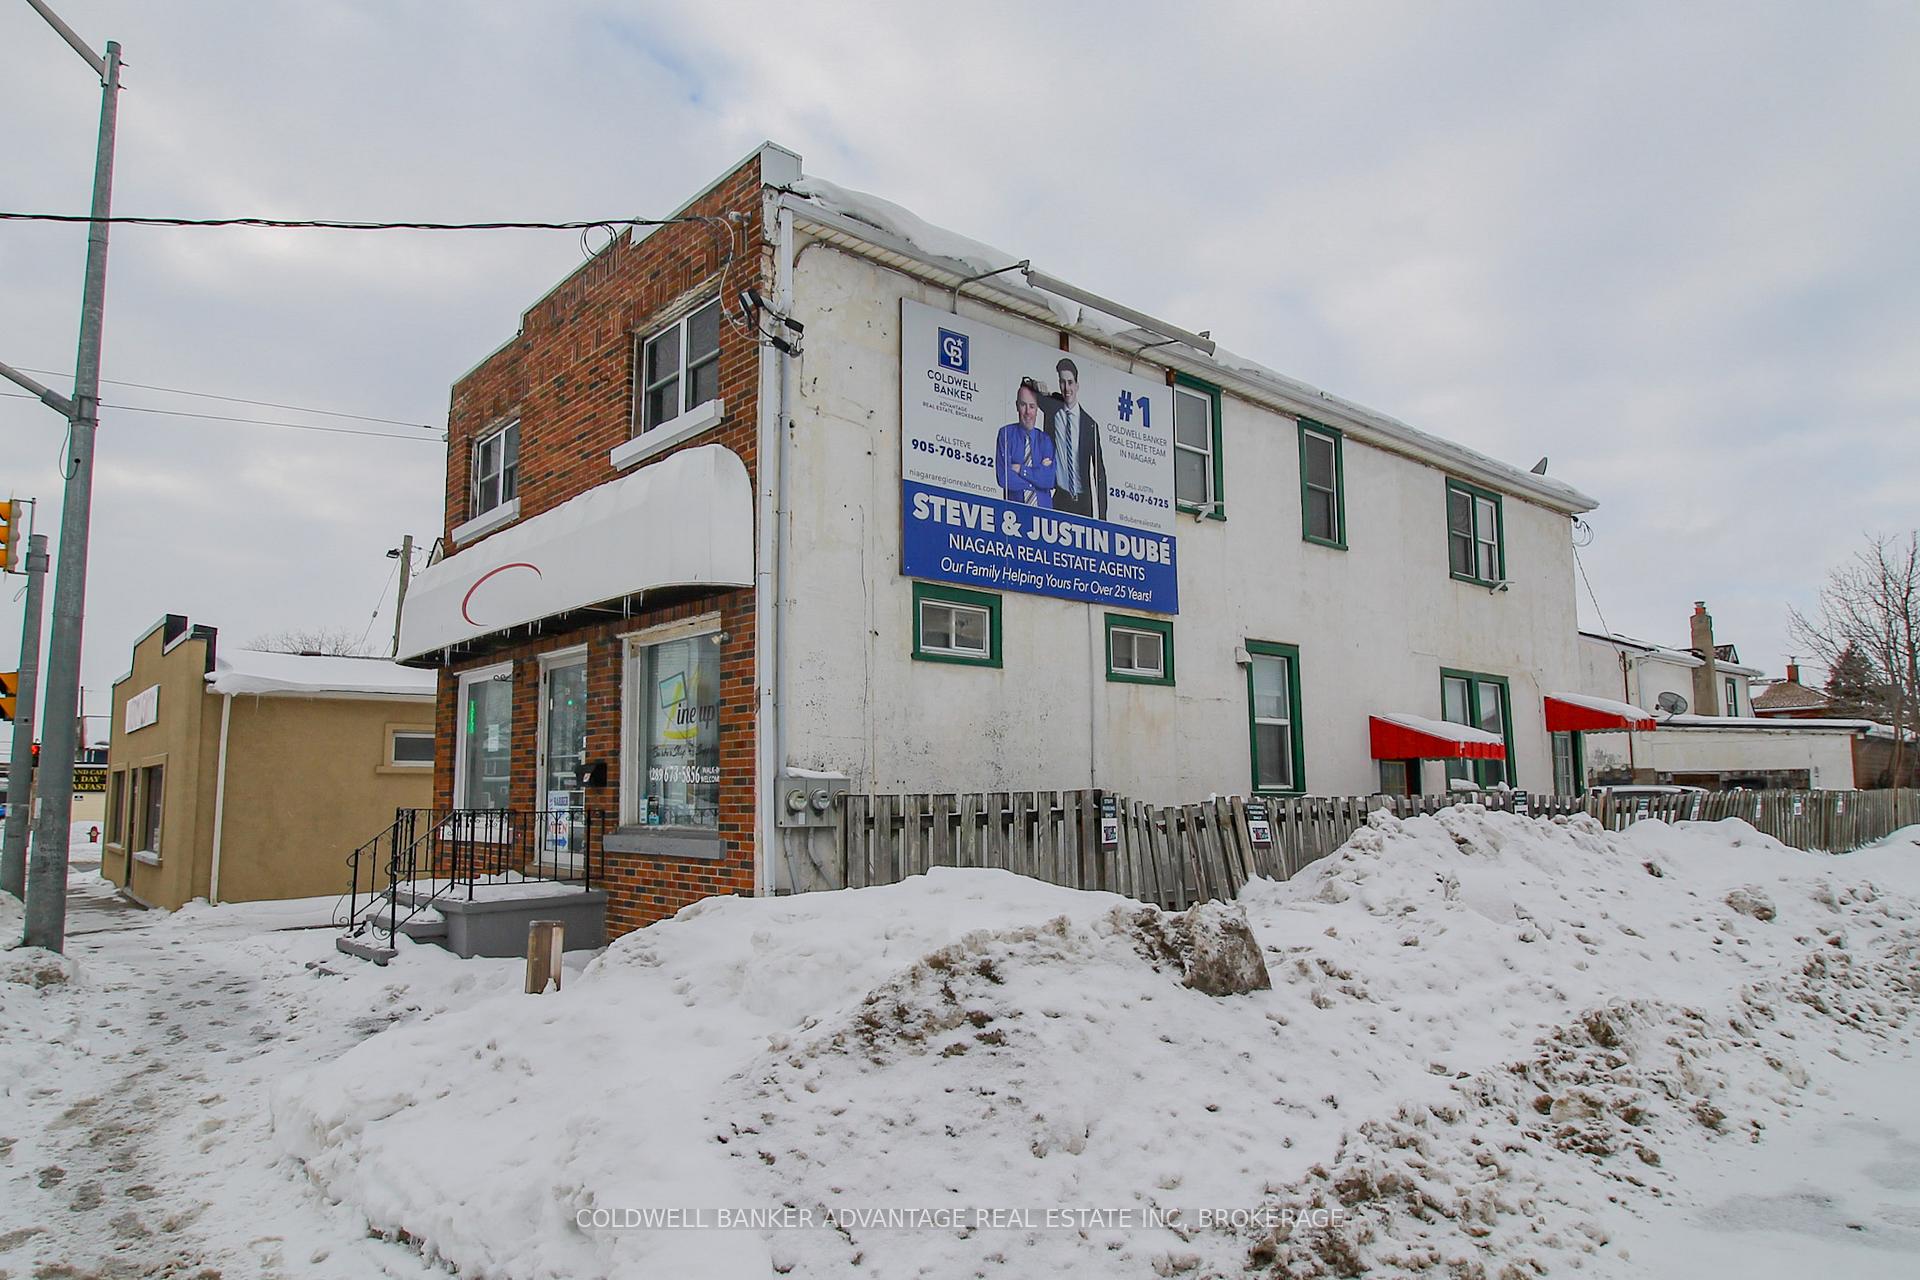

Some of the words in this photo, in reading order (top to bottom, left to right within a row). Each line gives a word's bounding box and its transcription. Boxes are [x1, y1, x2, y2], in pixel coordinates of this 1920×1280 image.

[927, 369, 979, 392] COLDWELL
[934, 383, 973, 402] BANKER
[922, 401, 936, 410] REAL
[955, 410, 984, 422] BROKERAGE
[940, 401, 967, 412] ADVANTAGE
[1118, 390, 1150, 428] #1
[936, 434, 951, 445] CALL
[953, 438, 972, 449] STEVE
[1107, 423, 1142, 439] COLDWELL
[1143, 433, 1167, 446] BANKER
[1109, 435, 1125, 447] REAL
[1126, 440, 1148, 453] ESTATE
[1149, 446, 1166, 457] TEAM
[912, 439, 994, 468] 905-708-5622
[1120, 449, 1127, 459] IN
[1128, 452, 1157, 466] NIAGARA
[909, 468, 997, 493] niagararegionrealtors.com
[1125, 481, 1136, 491] CALL
[1138, 485, 1154, 494] JUSTIN
[1109, 487, 1169, 509] 289-407-6725
[912, 492, 996, 533] STEVE
[1001, 510, 1022, 538] &
[1026, 515, 1109, 554] JUSTIN
[1115, 537, 1171, 565] DUBÉ
[949, 533, 1014, 559] NIAGARA
[1018, 545, 1050, 565] REAL
[1053, 551, 1097, 573] ESTATE
[1099, 560, 1146, 581] AGENTS
[941, 556, 965, 573] Our
[966, 560, 1001, 582] Family
[1002, 566, 1044, 589] Helping
[1046, 573, 1072, 590] Yours
[1073, 577, 1090, 593] For
[1090, 580, 1113, 596] Over
[1114, 584, 1126, 599] 25
[1128, 587, 1153, 602] Years!
[699, 704, 716, 730] up
